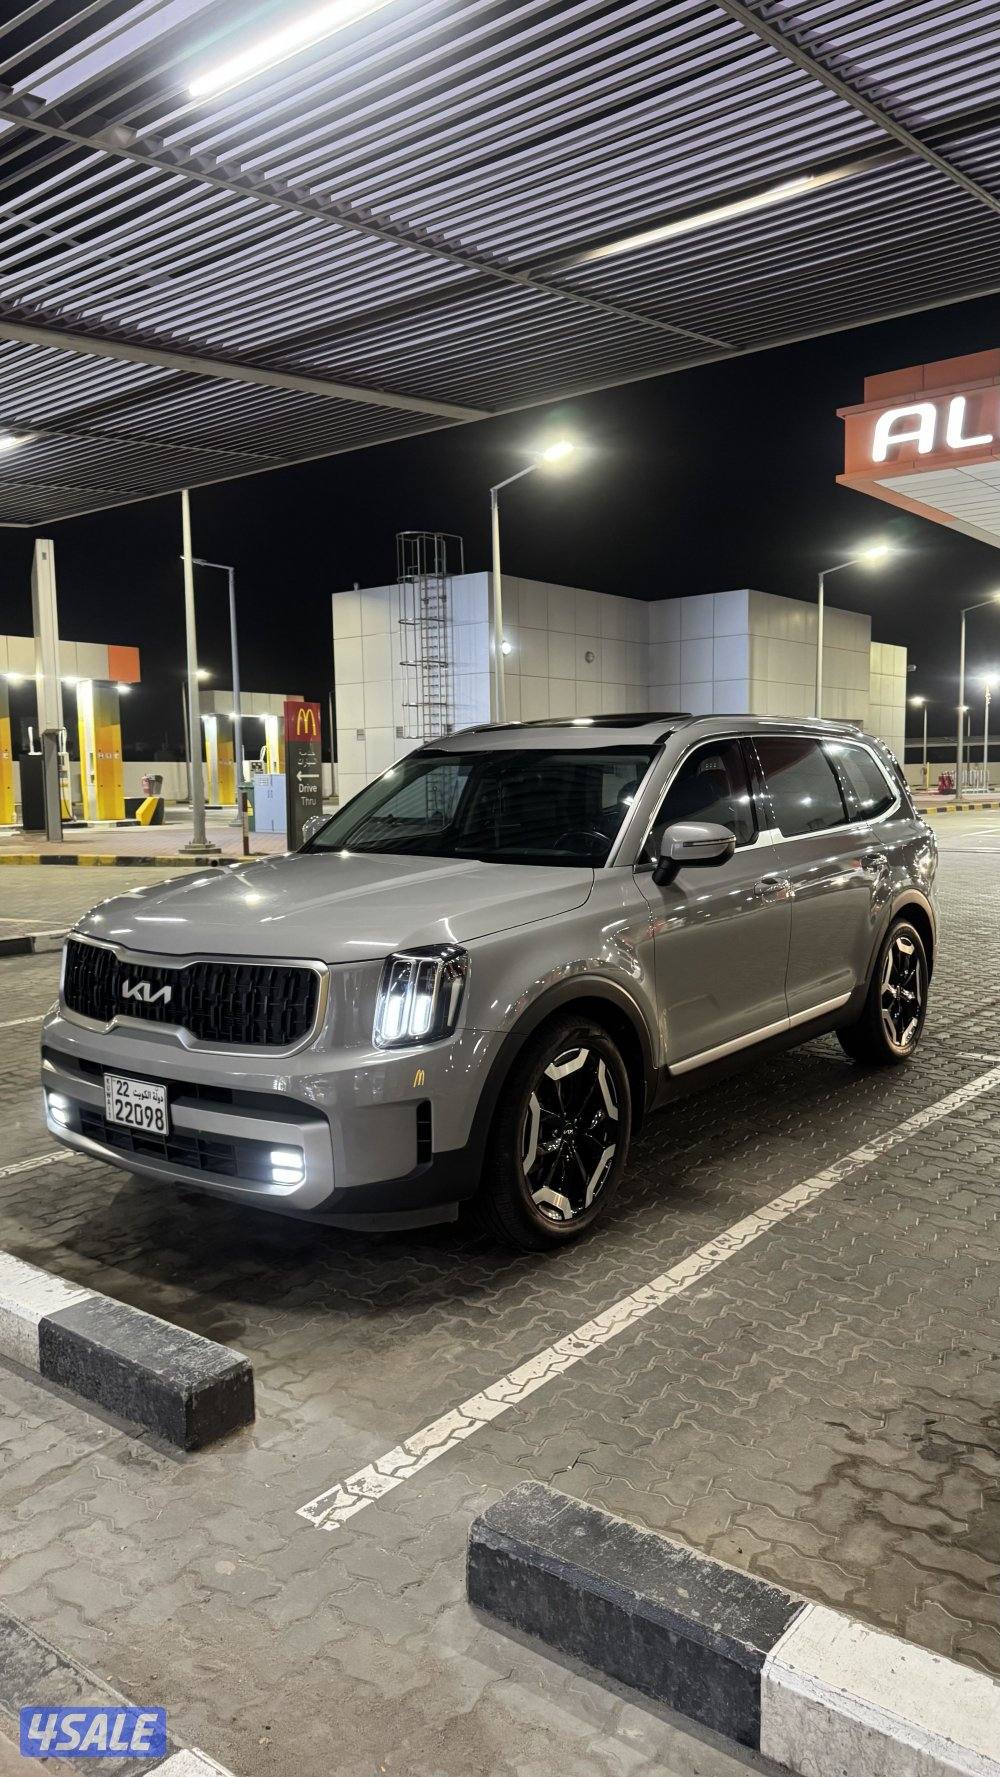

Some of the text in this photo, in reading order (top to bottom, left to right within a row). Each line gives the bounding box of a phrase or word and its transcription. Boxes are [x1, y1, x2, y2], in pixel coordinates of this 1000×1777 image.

[298, 783, 318, 793] Drive
[300, 796, 317, 806] Thru
[116, 1080, 130, 1098] 22
[115, 1099, 164, 1131] 22098
